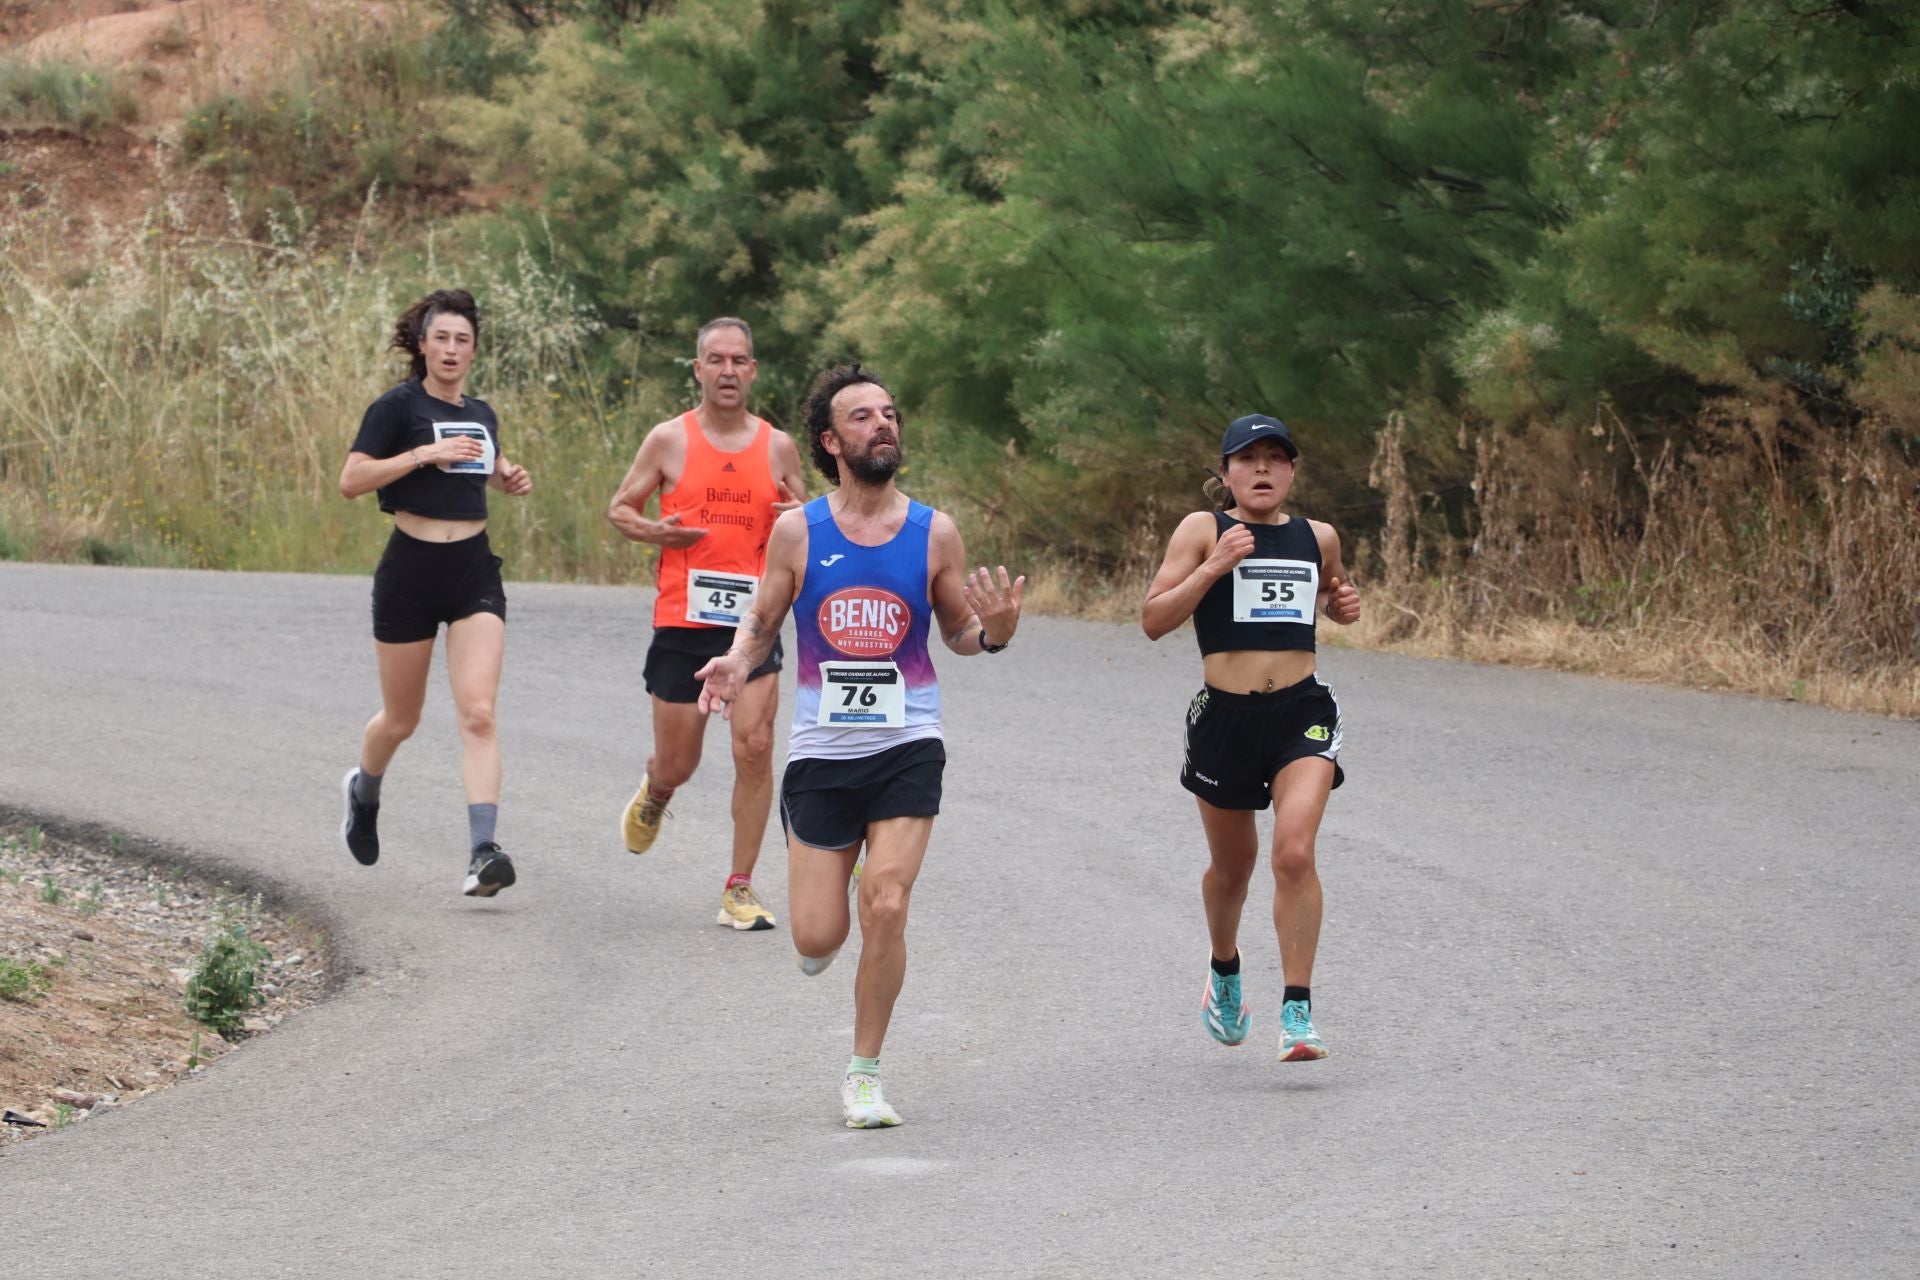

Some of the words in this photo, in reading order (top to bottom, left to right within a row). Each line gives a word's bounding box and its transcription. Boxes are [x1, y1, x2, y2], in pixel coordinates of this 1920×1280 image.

[706, 487, 752, 504] Buñuel
[700, 508, 754, 531] Running
[708, 591, 737, 609] 45
[1261, 582, 1295, 602] 55
[830, 598, 901, 636] BENIS
[848, 629, 883, 638] SABORES
[837, 639, 853, 648] MUY
[854, 640, 894, 650] NUESTROS
[841, 685, 877, 707] 76
